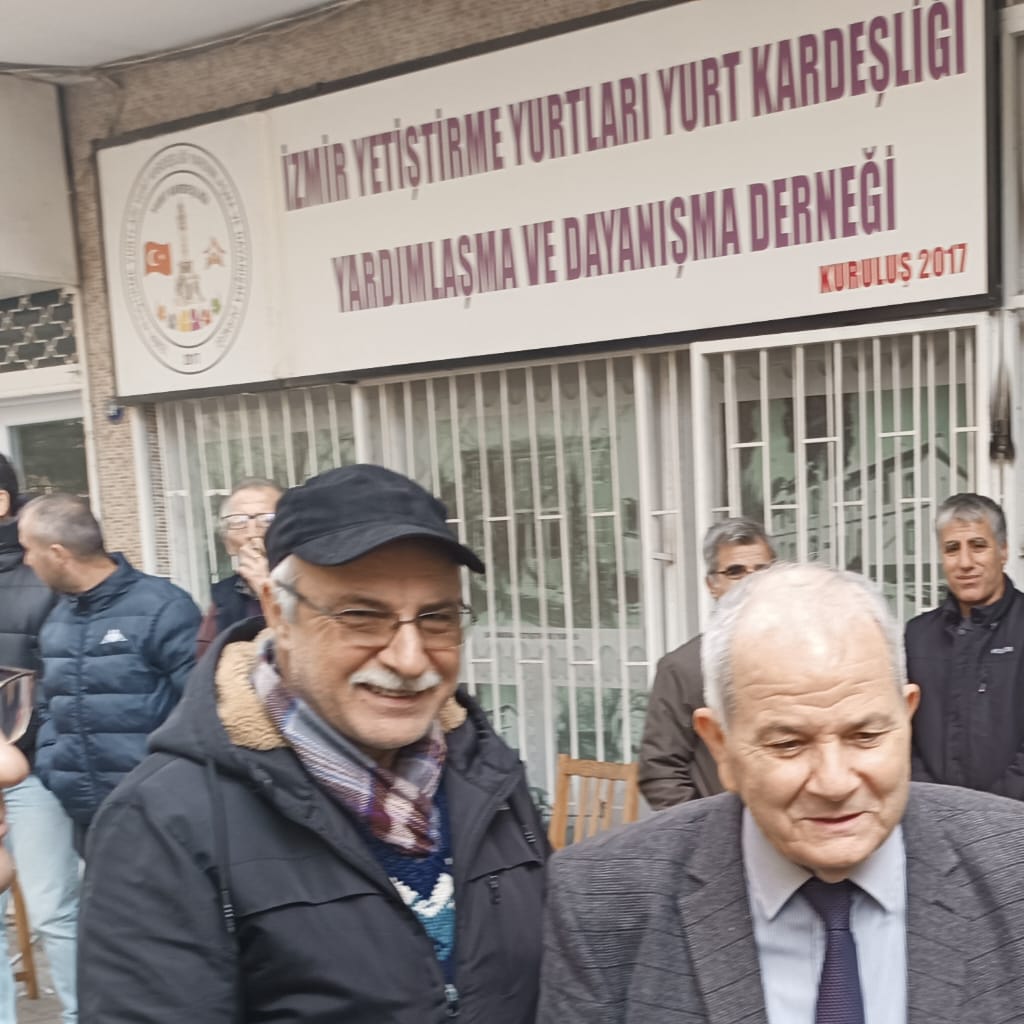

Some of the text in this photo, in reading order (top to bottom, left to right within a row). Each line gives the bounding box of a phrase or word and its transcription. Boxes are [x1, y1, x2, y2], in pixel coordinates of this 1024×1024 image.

[281, 134, 350, 212] İZMİR
[352, 108, 504, 200] YETİŞTİRME
[506, 73, 651, 166] YURTLARI
[657, 51, 742, 136] YURT
[330, 228, 518, 313] YARDIMLAŞMA
[520, 219, 558, 286] VE
[562, 187, 742, 281] DAYANIŞMA
[748, 144, 897, 252] DERNEĞİ
[818, 242, 968, 294] KURULUŞ 2017
